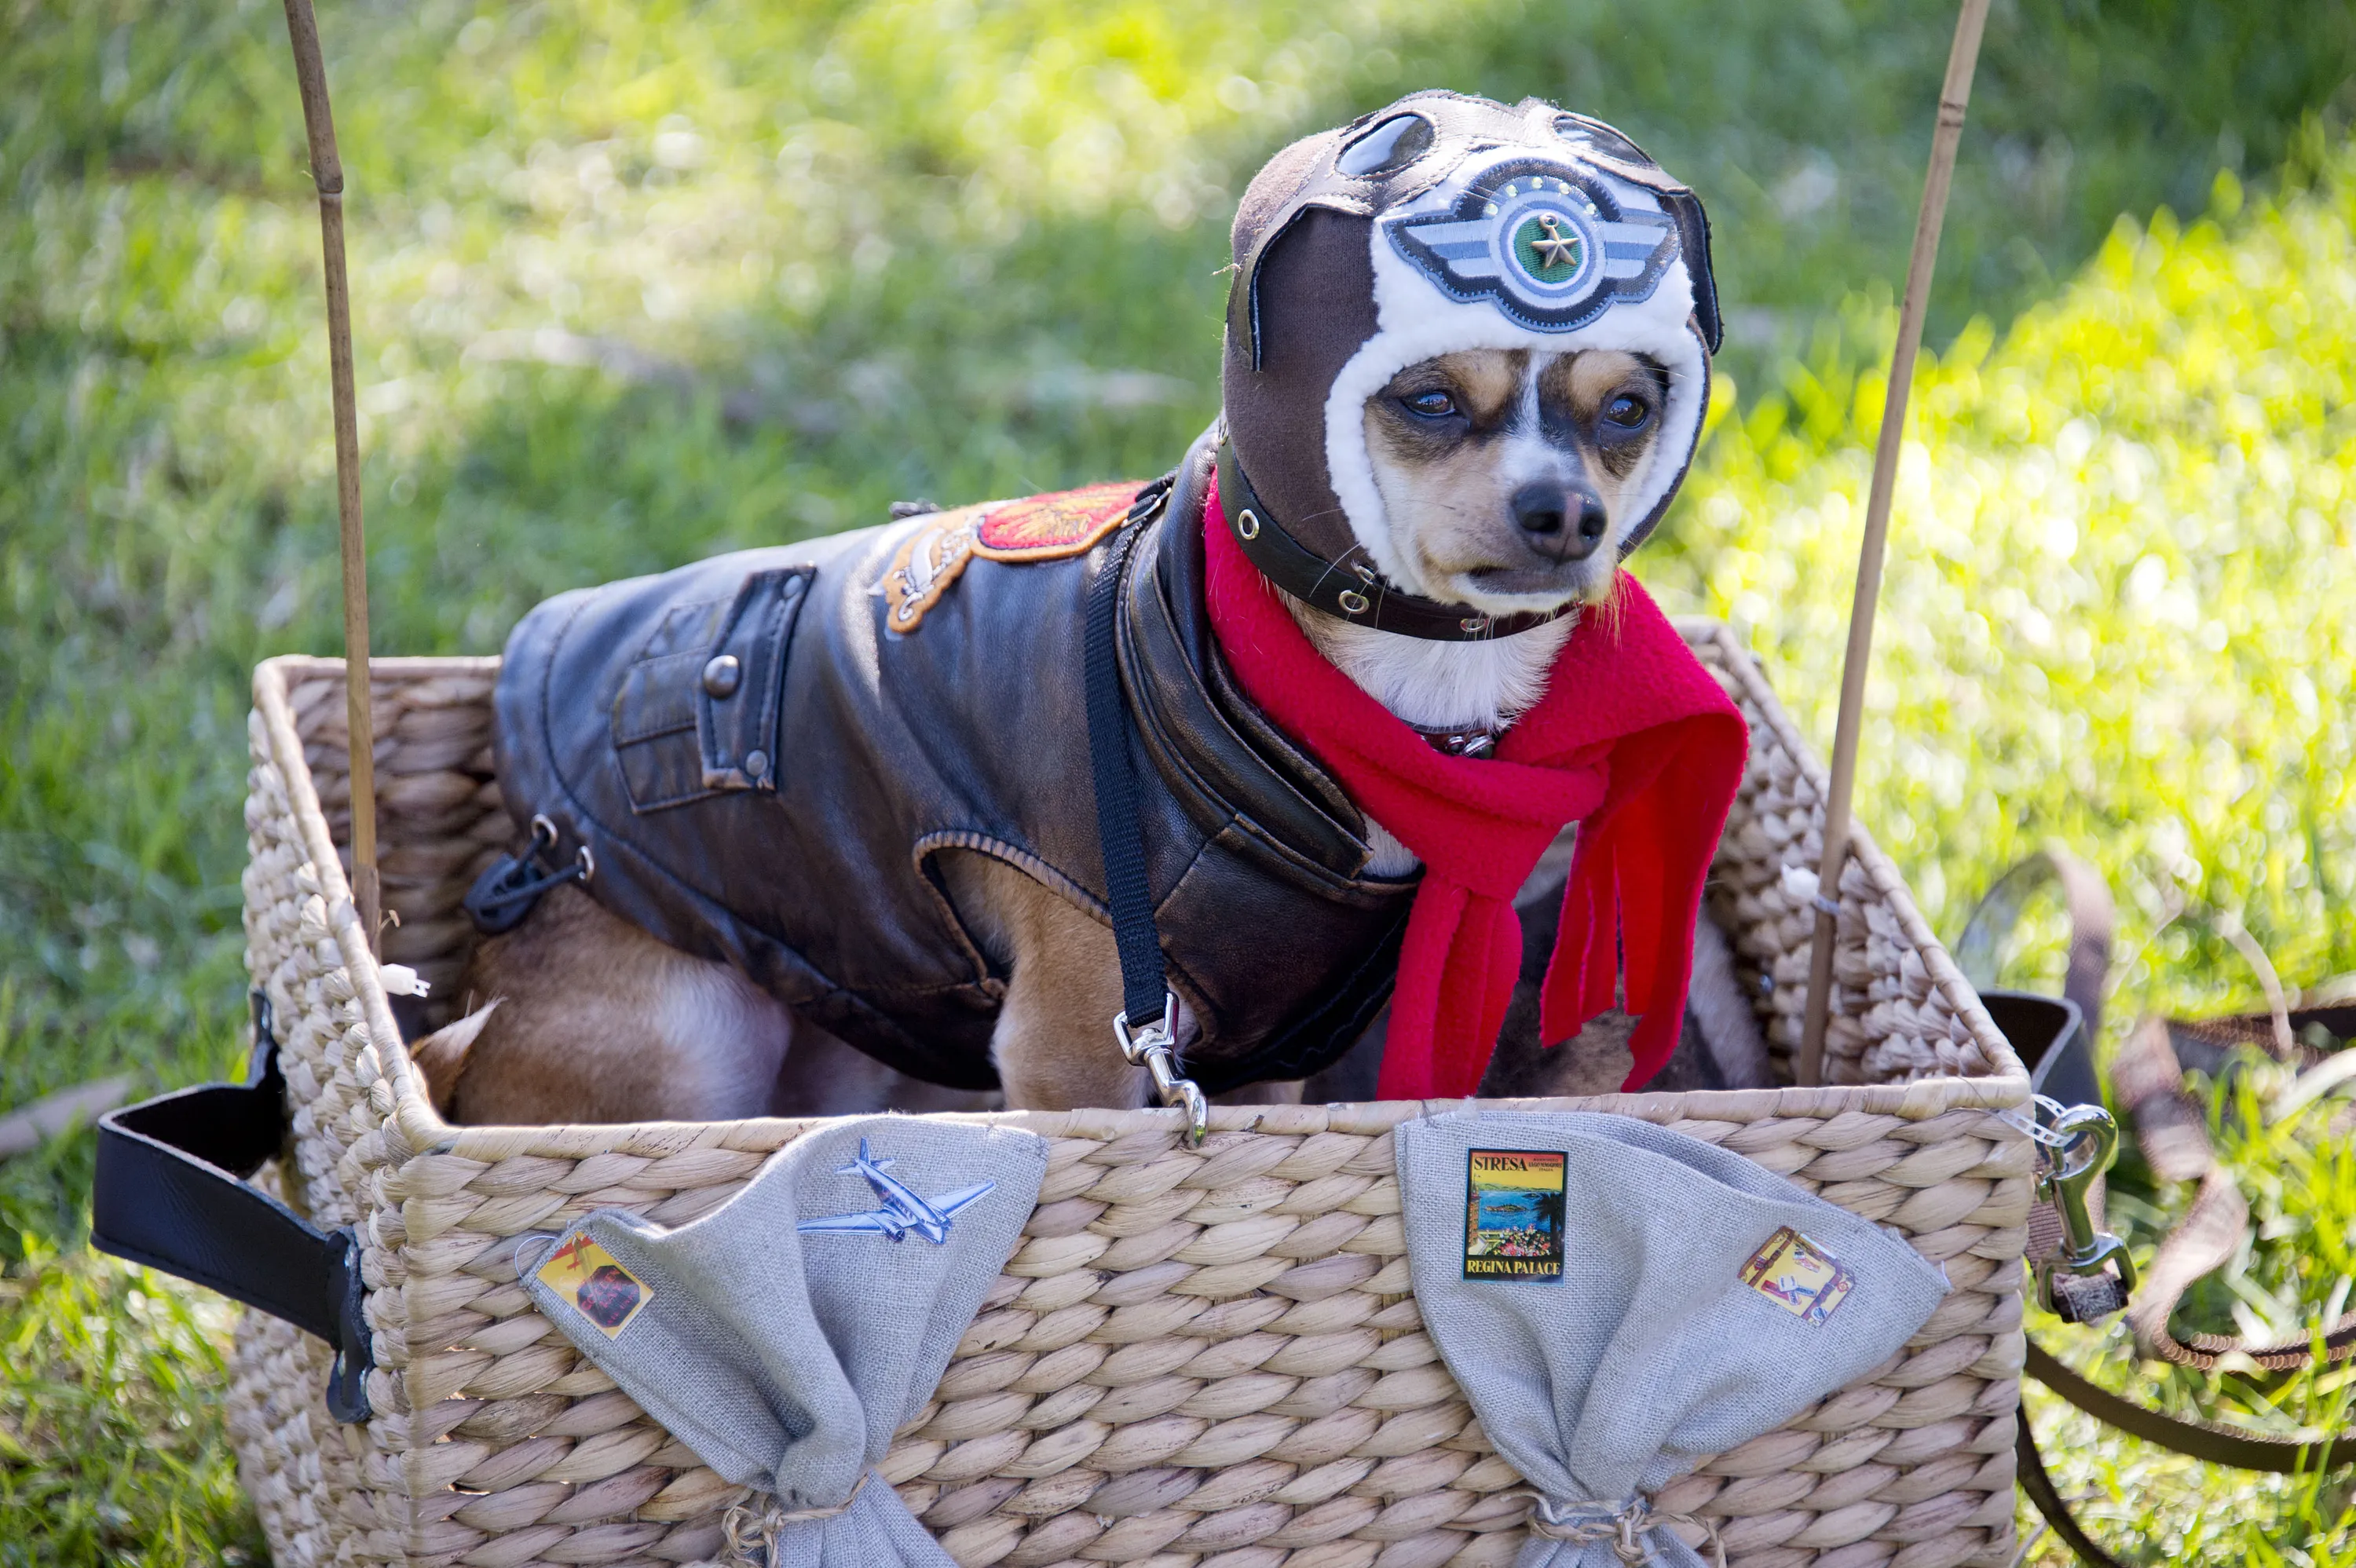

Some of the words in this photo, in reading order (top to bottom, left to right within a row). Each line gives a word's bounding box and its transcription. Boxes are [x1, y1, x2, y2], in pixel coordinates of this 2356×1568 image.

[1474, 1156, 1528, 1171] STRESA
[1467, 1259, 1512, 1274] REGINA
[1513, 1261, 1560, 1275] PALACE
